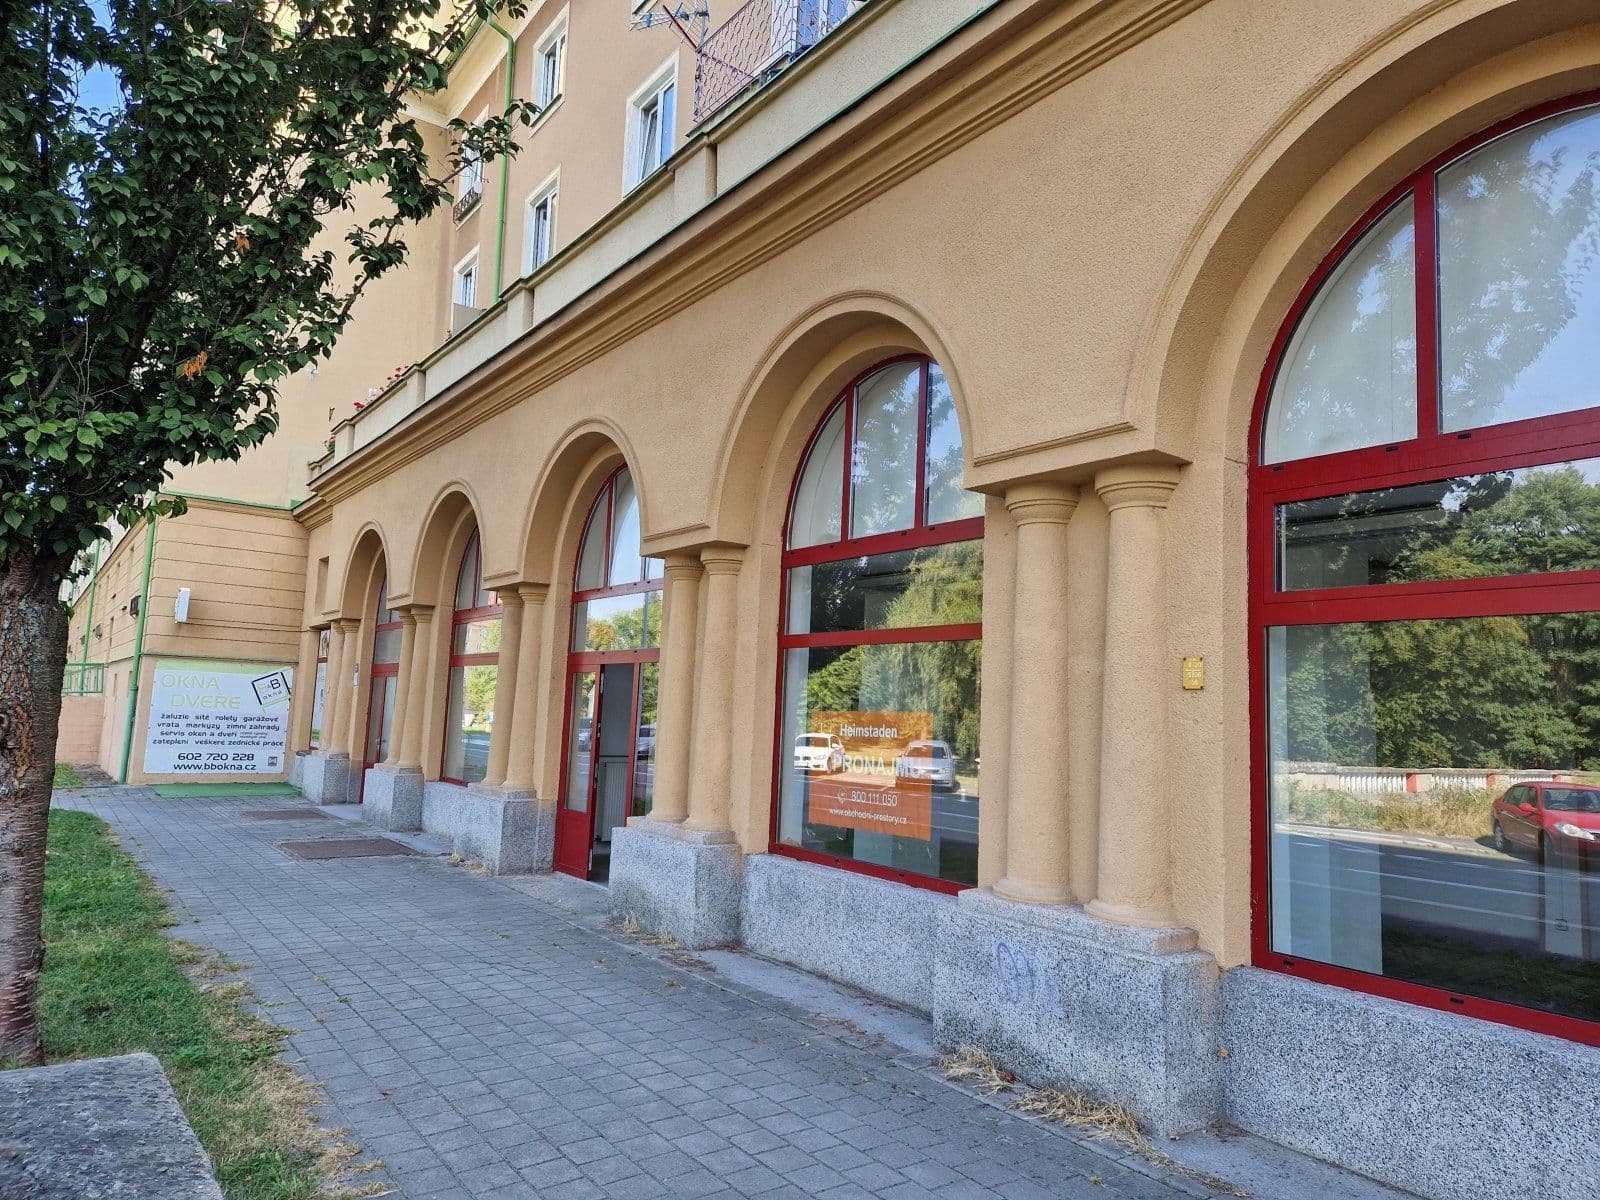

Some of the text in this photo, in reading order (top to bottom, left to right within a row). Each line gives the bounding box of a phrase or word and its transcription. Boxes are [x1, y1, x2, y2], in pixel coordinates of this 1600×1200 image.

[161, 673, 221, 690] OKNA
[215, 714, 238, 722] rolety
[249, 723, 280, 731] zahrady
[839, 723, 898, 739] Heimstaden
[178, 752, 255, 762] 602 720 228
[173, 762, 257, 771] www.bbokna.cz
[851, 790, 899, 807] 800 111 050
